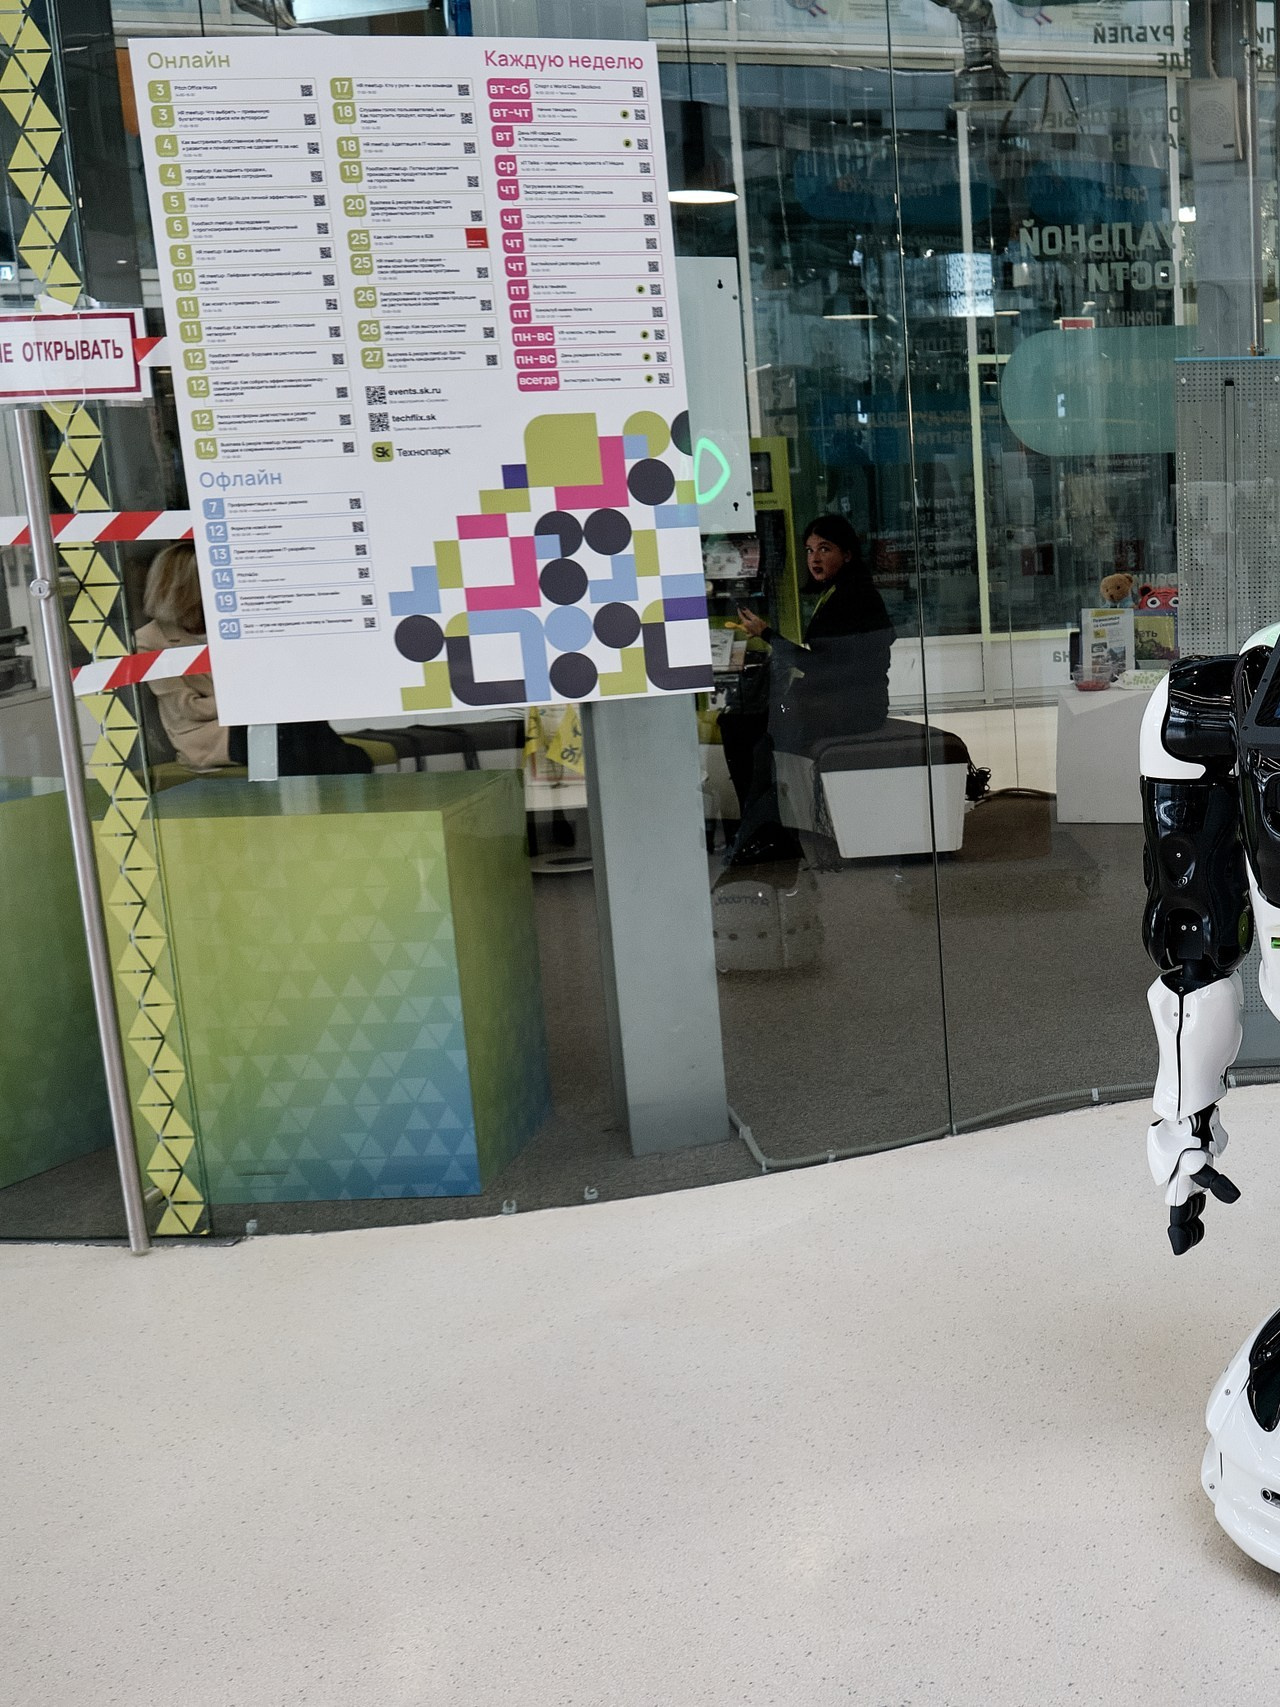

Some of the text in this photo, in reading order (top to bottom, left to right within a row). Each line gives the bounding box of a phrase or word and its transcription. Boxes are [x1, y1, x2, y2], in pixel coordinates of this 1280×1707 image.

[148, 50, 230, 69] Онлайн
[484, 50, 644, 72] Каждую неделю
[156, 84, 164, 96] 3
[335, 82, 349, 93] 17
[490, 83, 528, 95] вт-сб
[160, 108, 168, 121] 3
[337, 106, 352, 117] 18
[492, 108, 530, 118] вт-чт
[496, 132, 511, 141] вт
[164, 138, 172, 150] 4
[341, 140, 357, 152] 18
[344, 165, 360, 177] 19
[498, 162, 515, 173] ср
[167, 168, 175, 179] 4
[500, 185, 516, 194] чт
[170, 196, 179, 208] 5
[346, 198, 365, 210] 20
[503, 215, 520, 224] чт
[174, 220, 182, 231] 6
[350, 234, 368, 244] 25
[506, 239, 522, 248] чт
[178, 248, 186, 260] 6
[353, 258, 371, 269] 25
[508, 263, 524, 272] чт
[176, 272, 192, 284] 10
[510, 285, 527, 295] пт
[357, 291, 375, 301] 26
[182, 300, 195, 312] 11
[513, 309, 529, 318] пт
[184, 325, 198, 336] 11
[360, 324, 378, 335] 26
[514, 332, 553, 341] пн-вс
[22, 339, 124, 362] ОТКРЫВАТЬ
[188, 352, 203, 364] 12
[364, 352, 380, 362] 27
[516, 355, 555, 364] пн-вс
[191, 380, 207, 391] 12
[519, 376, 558, 386] всегда
[388, 387, 441, 396] events.sk.ru
[194, 414, 210, 425] 12
[392, 414, 436, 422] techflix.sk
[198, 442, 214, 453] 14
[376, 447, 391, 458] Sk
[396, 448, 450, 457] Технопарк
[199, 470, 282, 492] Офлайн
[209, 502, 217, 513] 7
[209, 525, 224, 537] 12
[212, 549, 227, 560] 13
[215, 572, 230, 583] 14
[218, 595, 233, 606] 19
[220, 622, 238, 634] 20
